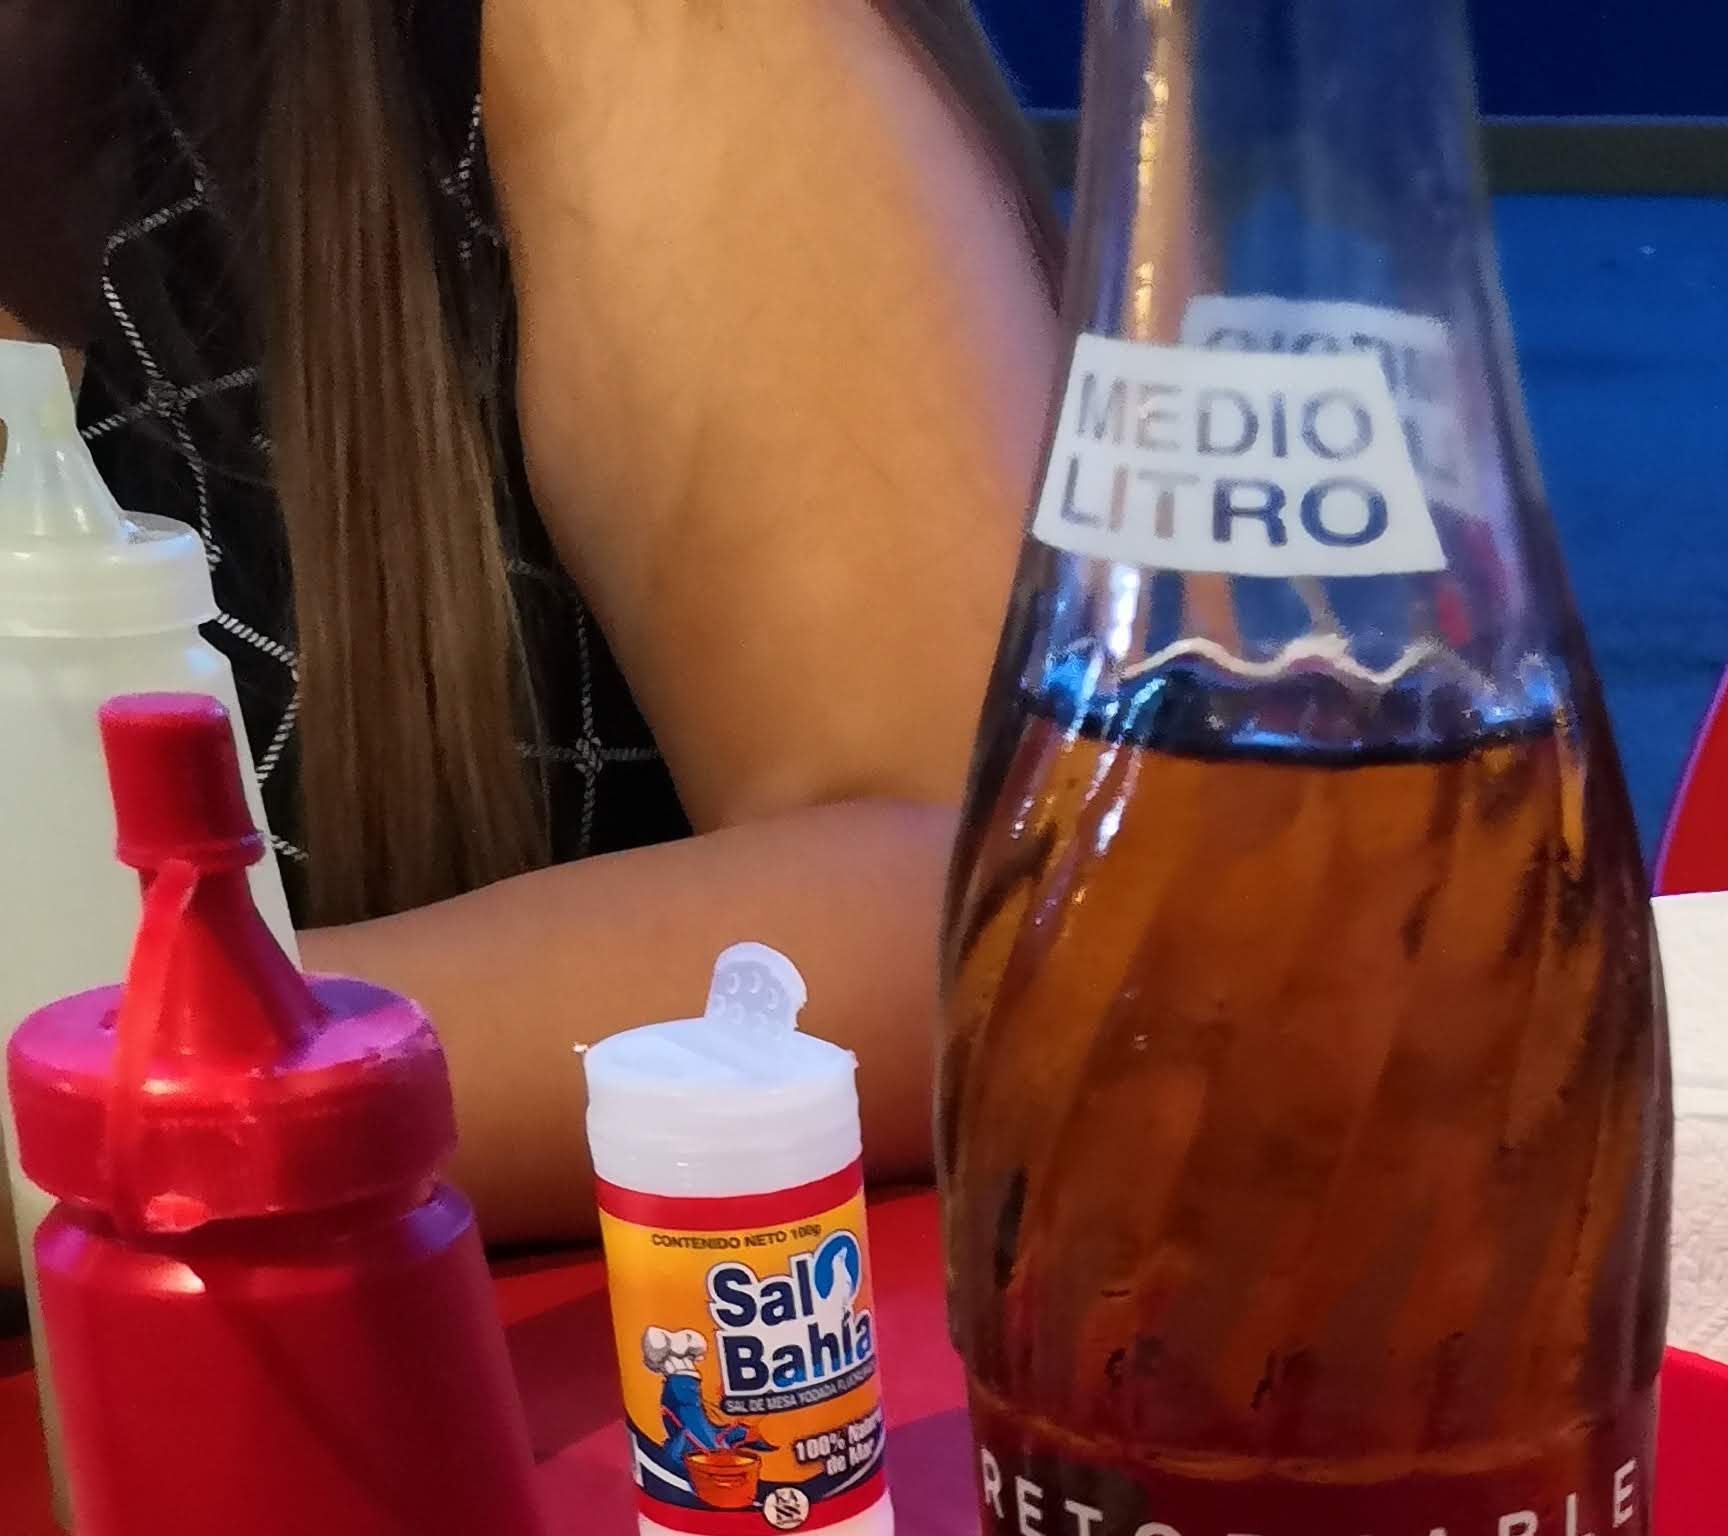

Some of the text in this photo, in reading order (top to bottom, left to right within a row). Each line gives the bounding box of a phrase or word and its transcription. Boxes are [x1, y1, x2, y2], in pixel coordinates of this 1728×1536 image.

[1077, 371, 1375, 460] MEDIO
[1060, 455, 1389, 548] LITRO
[651, 1233, 741, 1250] CONTENIDO
[745, 1231, 787, 1248] NETO
[713, 1259, 814, 1328] Sal
[722, 1312, 872, 1392] Bahía
[726, 1398, 748, 1413] SAL
[749, 1397, 766, 1412] DE
[767, 1394, 798, 1410] MESA
[795, 1430, 846, 1462] 100%
